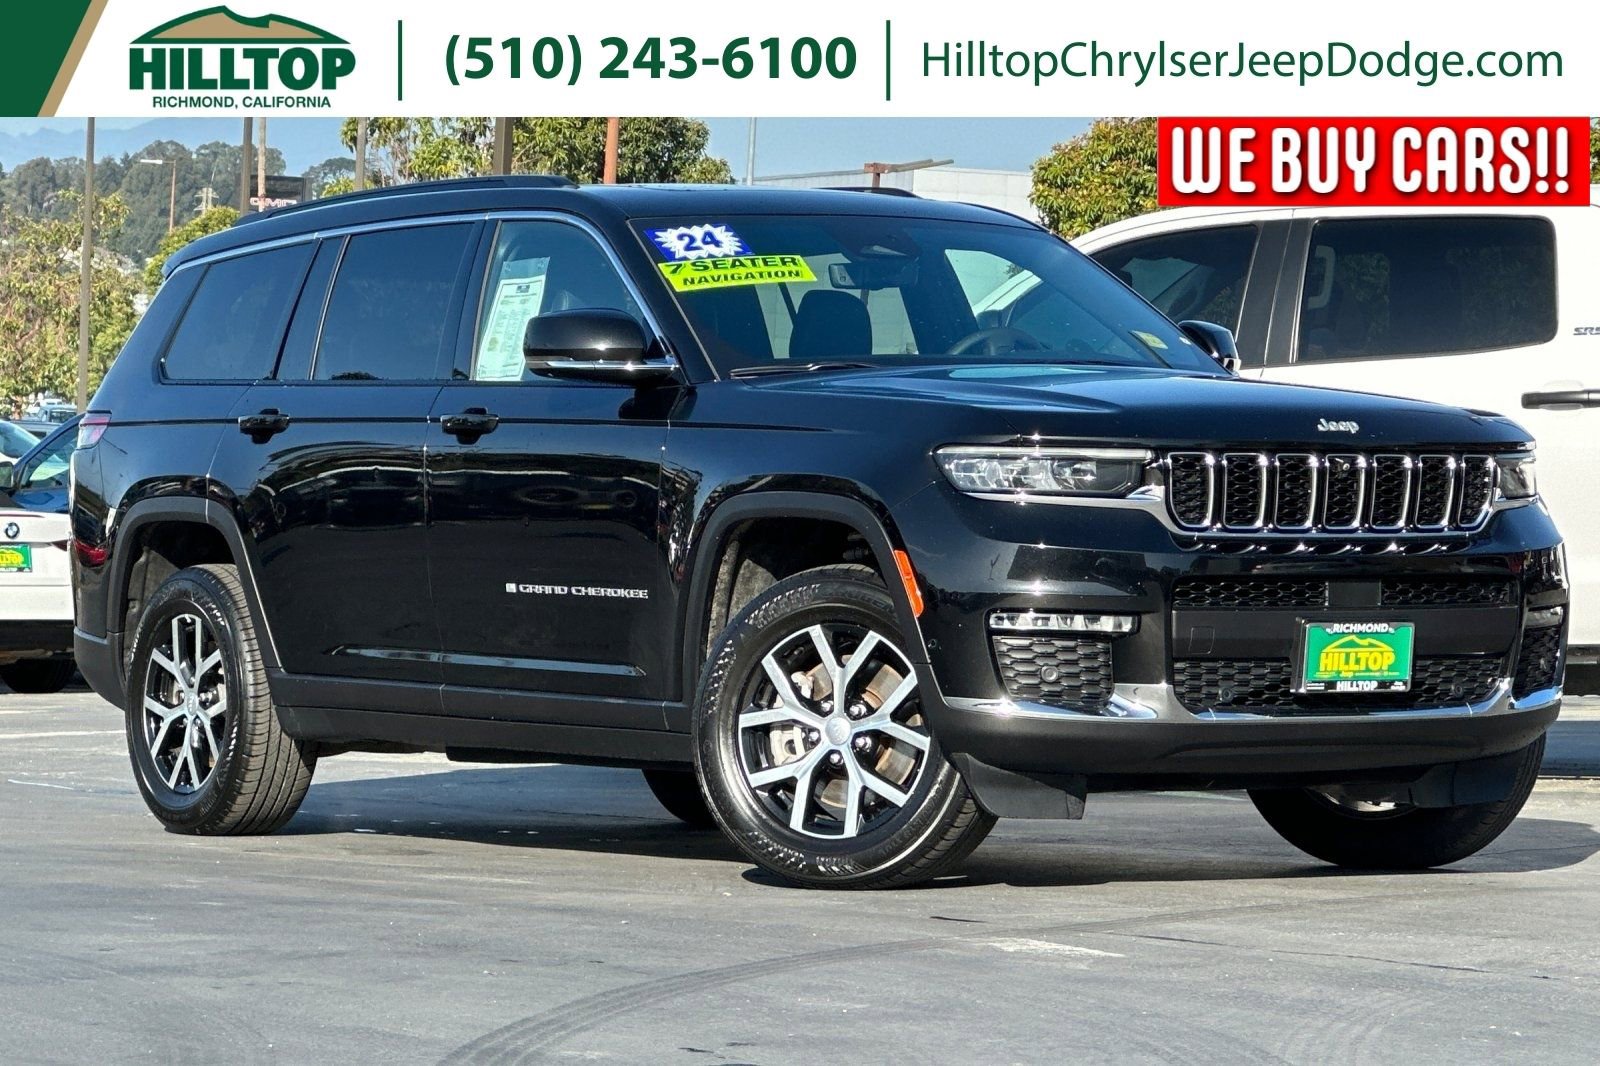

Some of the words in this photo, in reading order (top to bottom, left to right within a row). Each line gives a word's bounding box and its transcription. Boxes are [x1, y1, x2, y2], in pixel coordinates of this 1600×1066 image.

[676, 231, 723, 251] 24
[690, 256, 798, 272] SEATER
[683, 270, 801, 286] NAVIGATION
[1317, 418, 1360, 434] Jeep
[518, 584, 569, 595] GRAND
[571, 586, 649, 599] CHEROKEE
[1333, 623, 1389, 633] RICHMOND
[1319, 652, 1396, 672] HILLTOP
[1336, 681, 1379, 691] HILLTOP
